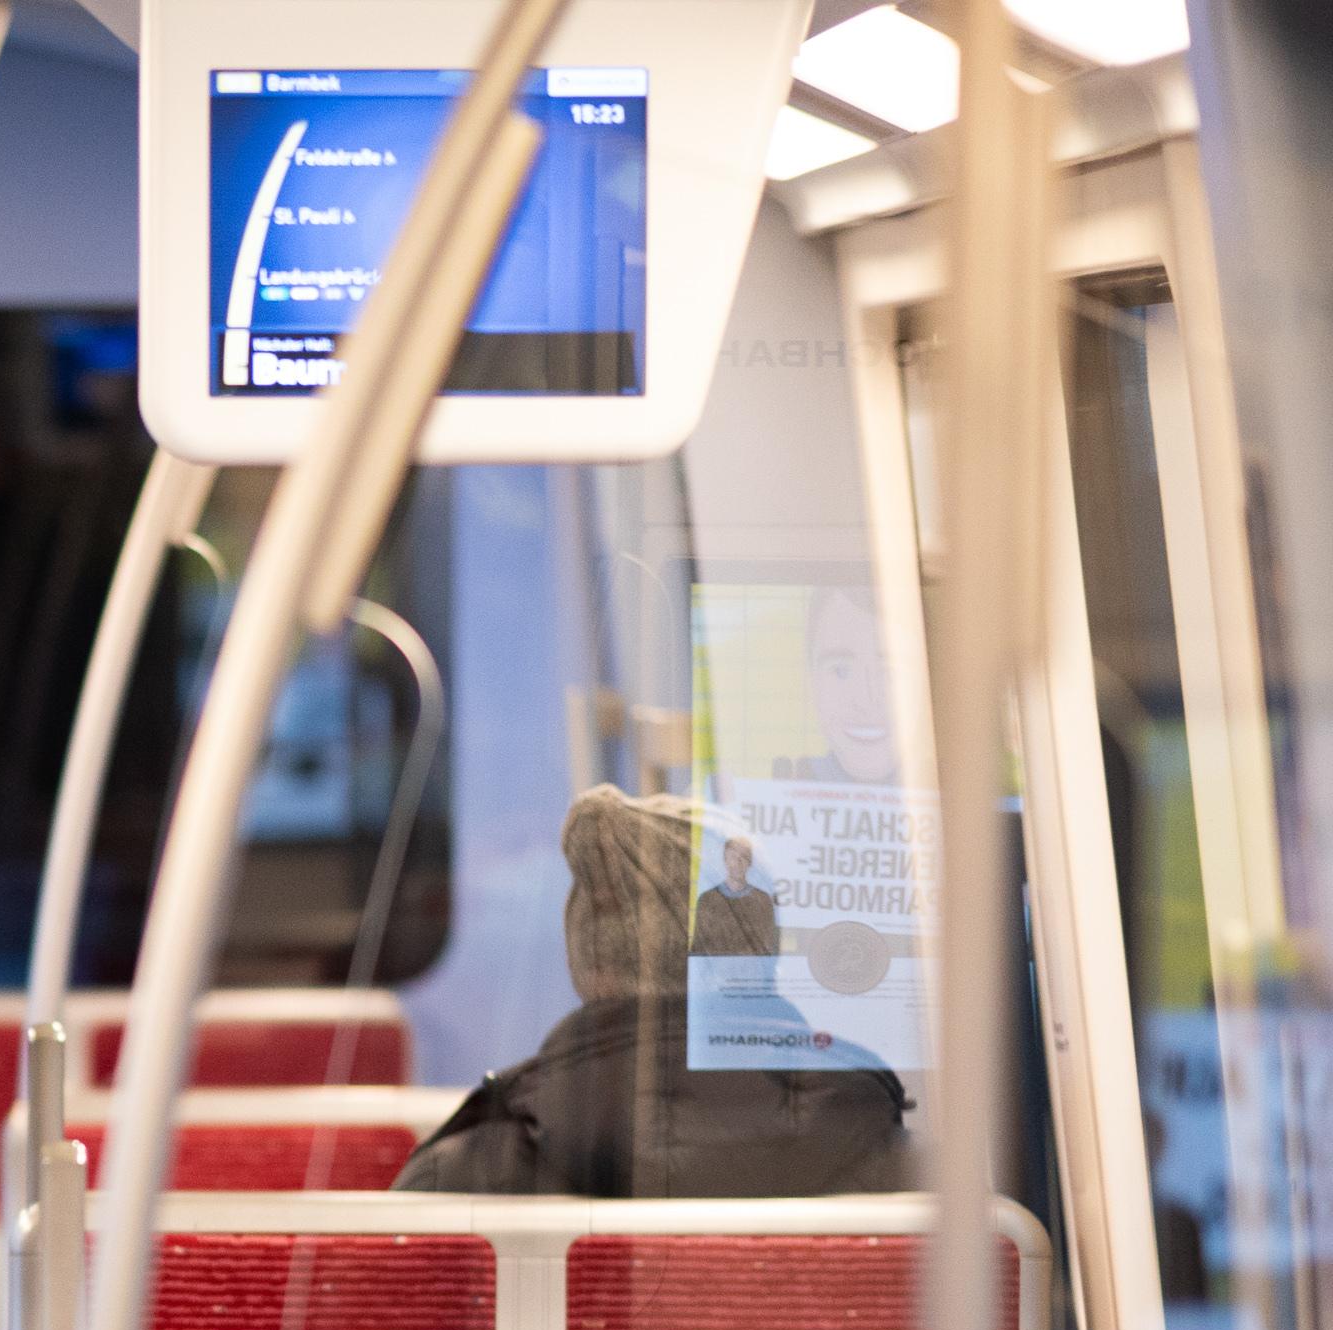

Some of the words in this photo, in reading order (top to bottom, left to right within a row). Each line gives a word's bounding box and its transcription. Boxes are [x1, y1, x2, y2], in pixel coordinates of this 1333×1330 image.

[266, 74, 341, 92] Barmbek
[295, 149, 382, 167] Feldstraße
[274, 209, 296, 225] St.
[299, 208, 342, 225] Pauli
